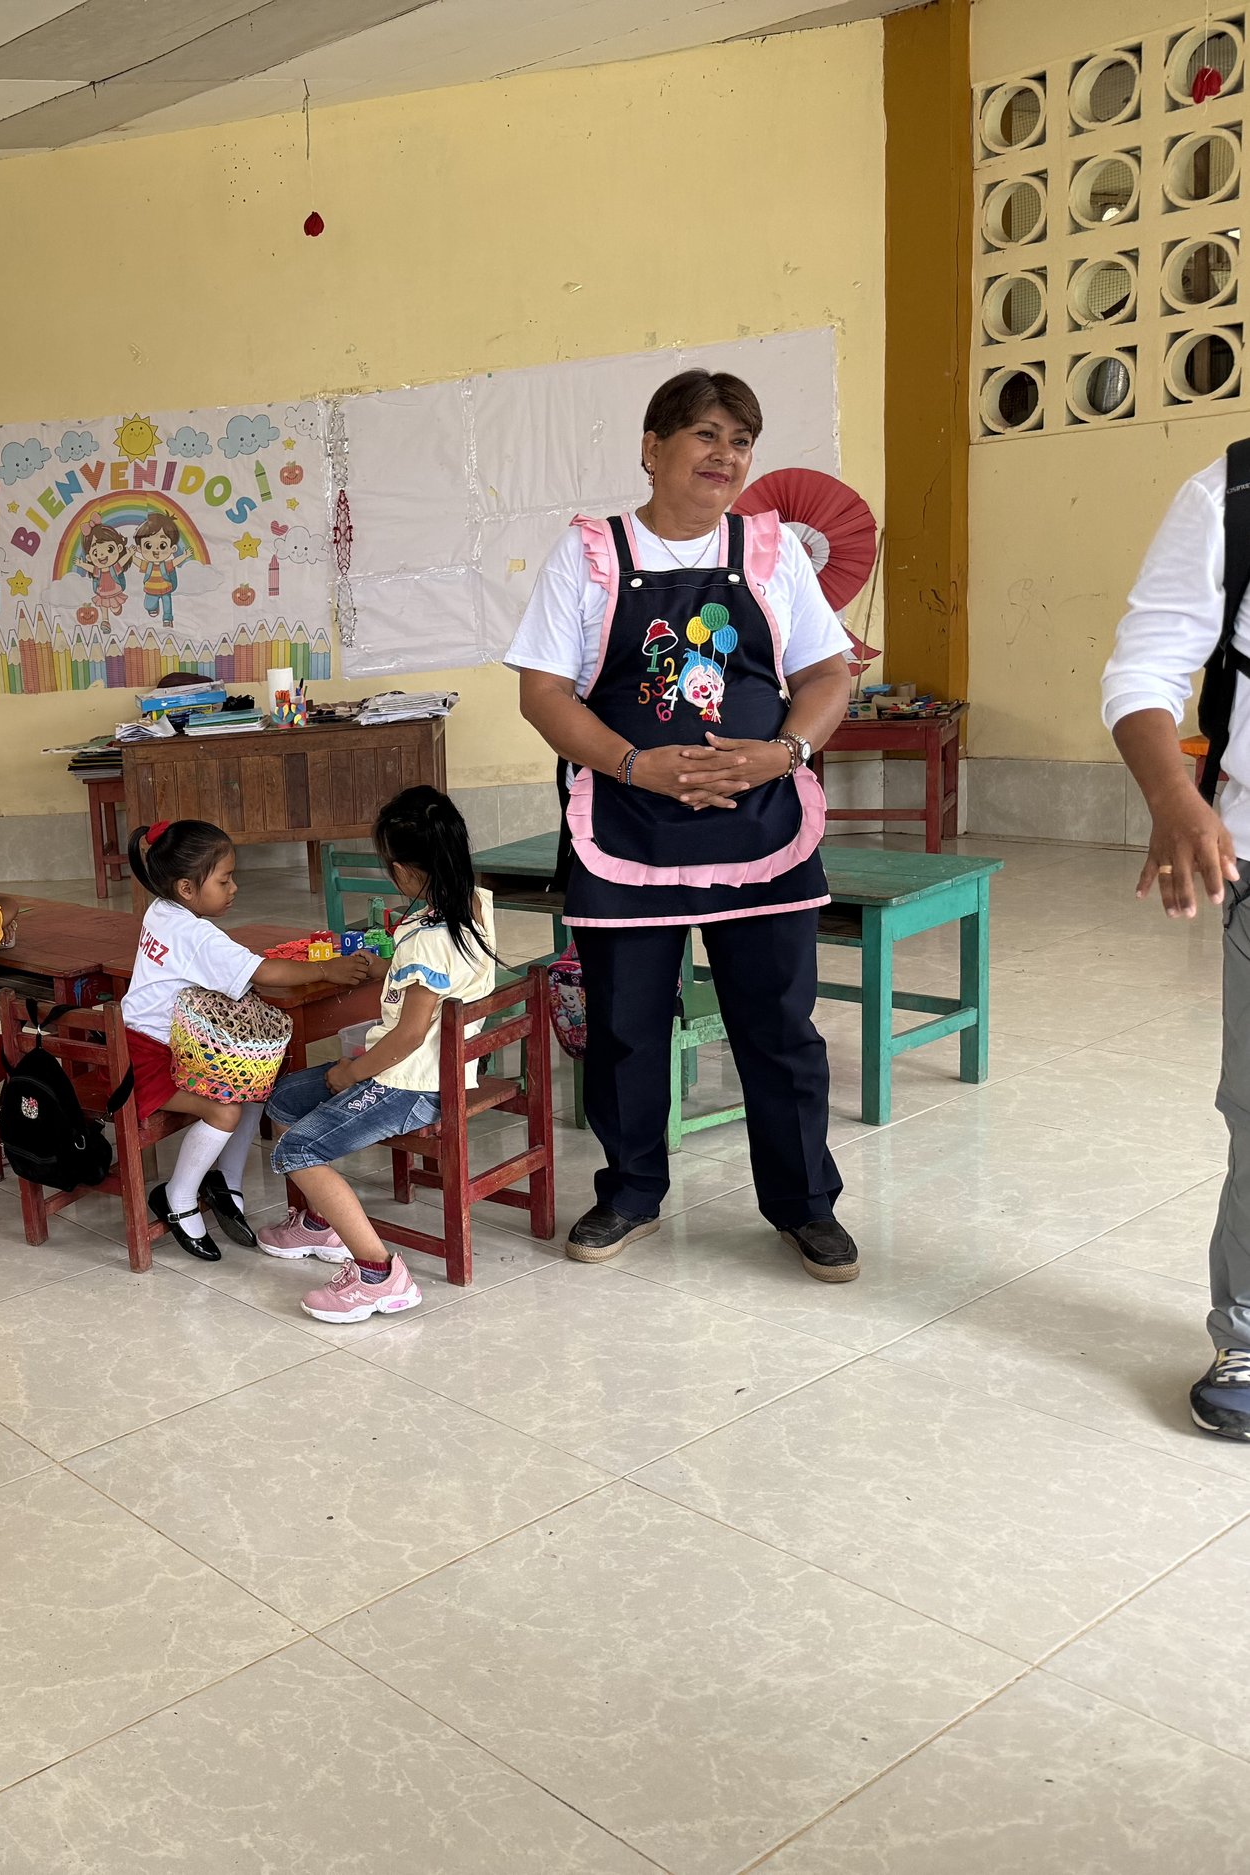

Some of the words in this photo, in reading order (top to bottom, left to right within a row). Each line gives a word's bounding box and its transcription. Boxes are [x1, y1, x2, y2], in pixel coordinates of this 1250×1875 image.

[10, 459, 258, 557] BIENVENIDOS
[646, 644, 659, 672] 1
[663, 657, 679, 683] 2
[637, 682, 650, 705] 5
[651, 676, 666, 697] 3
[662, 684, 679, 711] 4
[655, 702, 672, 723] 6
[309, 947, 321, 959] 14
[344, 937, 351, 947] 0
